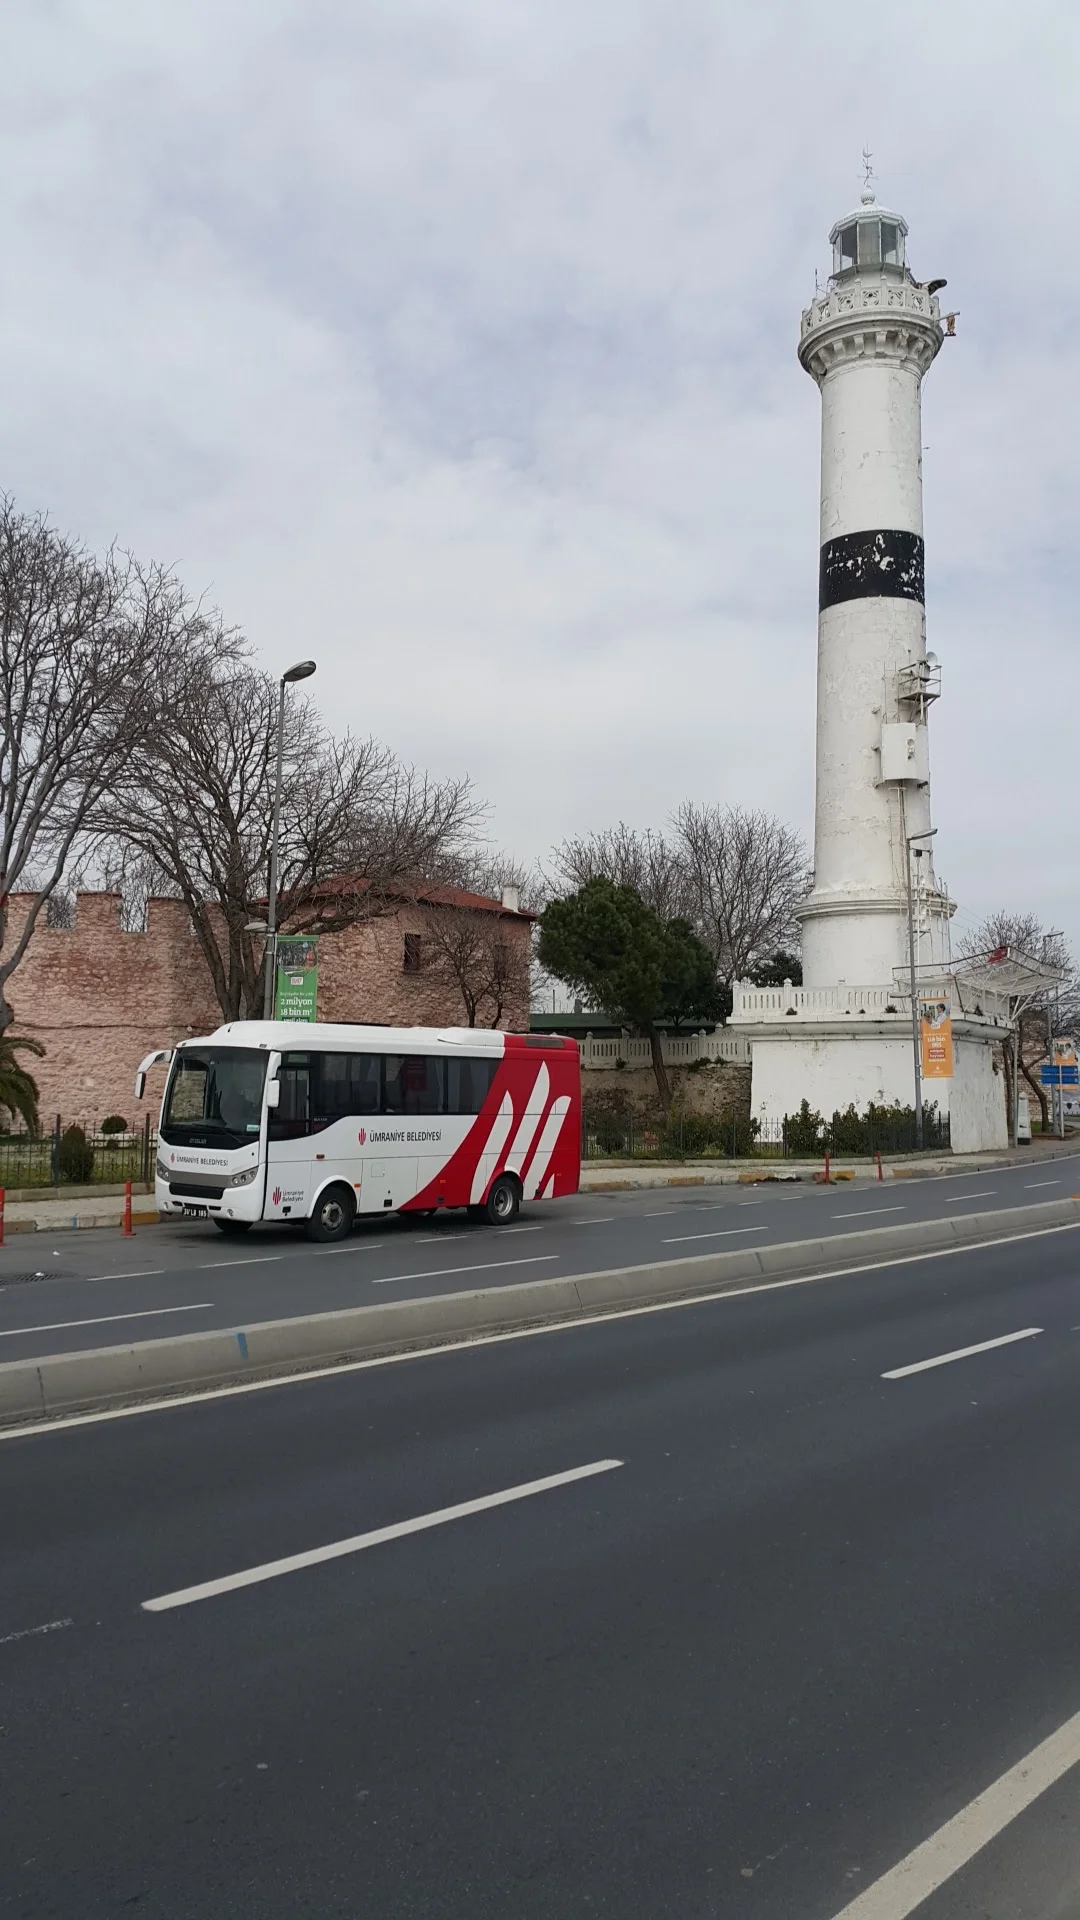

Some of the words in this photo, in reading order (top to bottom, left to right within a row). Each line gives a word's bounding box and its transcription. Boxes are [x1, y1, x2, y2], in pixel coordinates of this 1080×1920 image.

[286, 997, 312, 1007] milyon
[289, 1007, 301, 1015] bin
[370, 1129, 405, 1142] ÜMRANİYE
[406, 1128, 442, 1141] BELEDİYESİ
